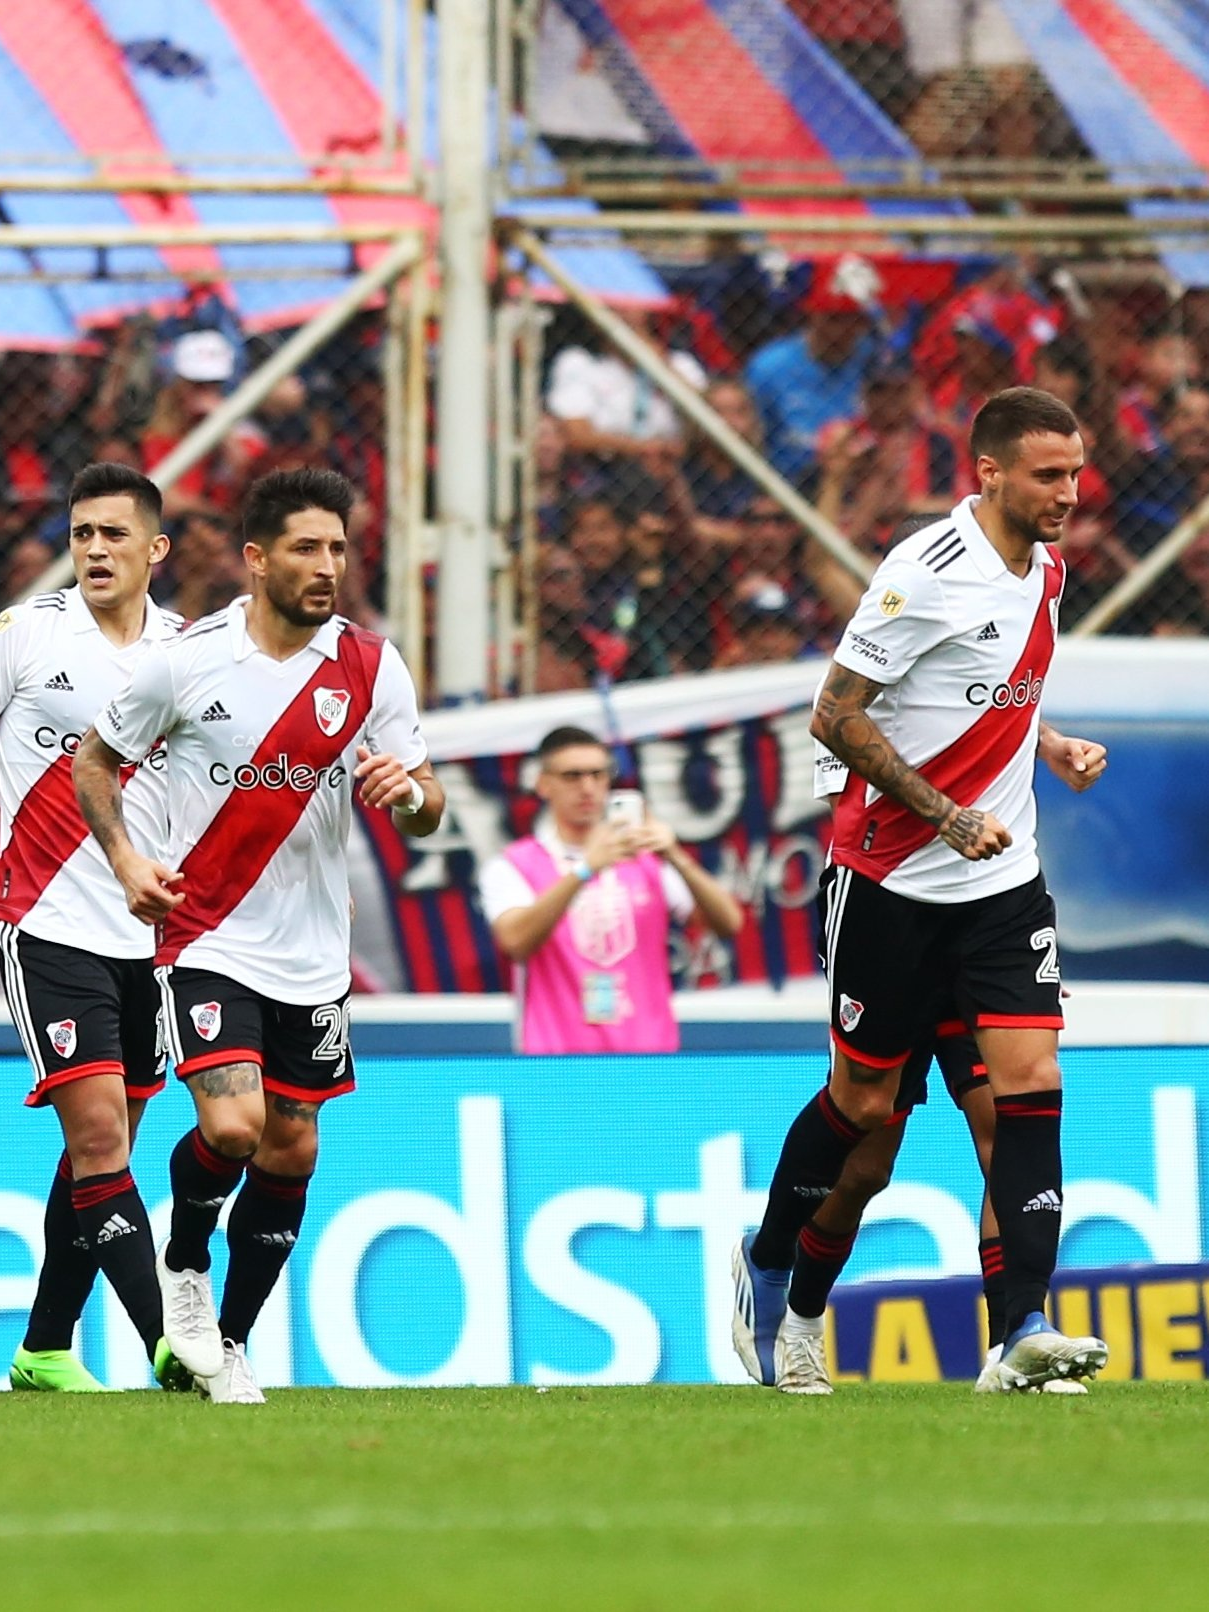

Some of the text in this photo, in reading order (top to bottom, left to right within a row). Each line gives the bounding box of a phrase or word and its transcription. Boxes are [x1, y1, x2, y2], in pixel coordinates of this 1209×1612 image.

[44, 682, 75, 692] adidas
[201, 713, 232, 722] adidas
[208, 753, 348, 792] codere
[824, 1279, 1209, 1382] LA UE
